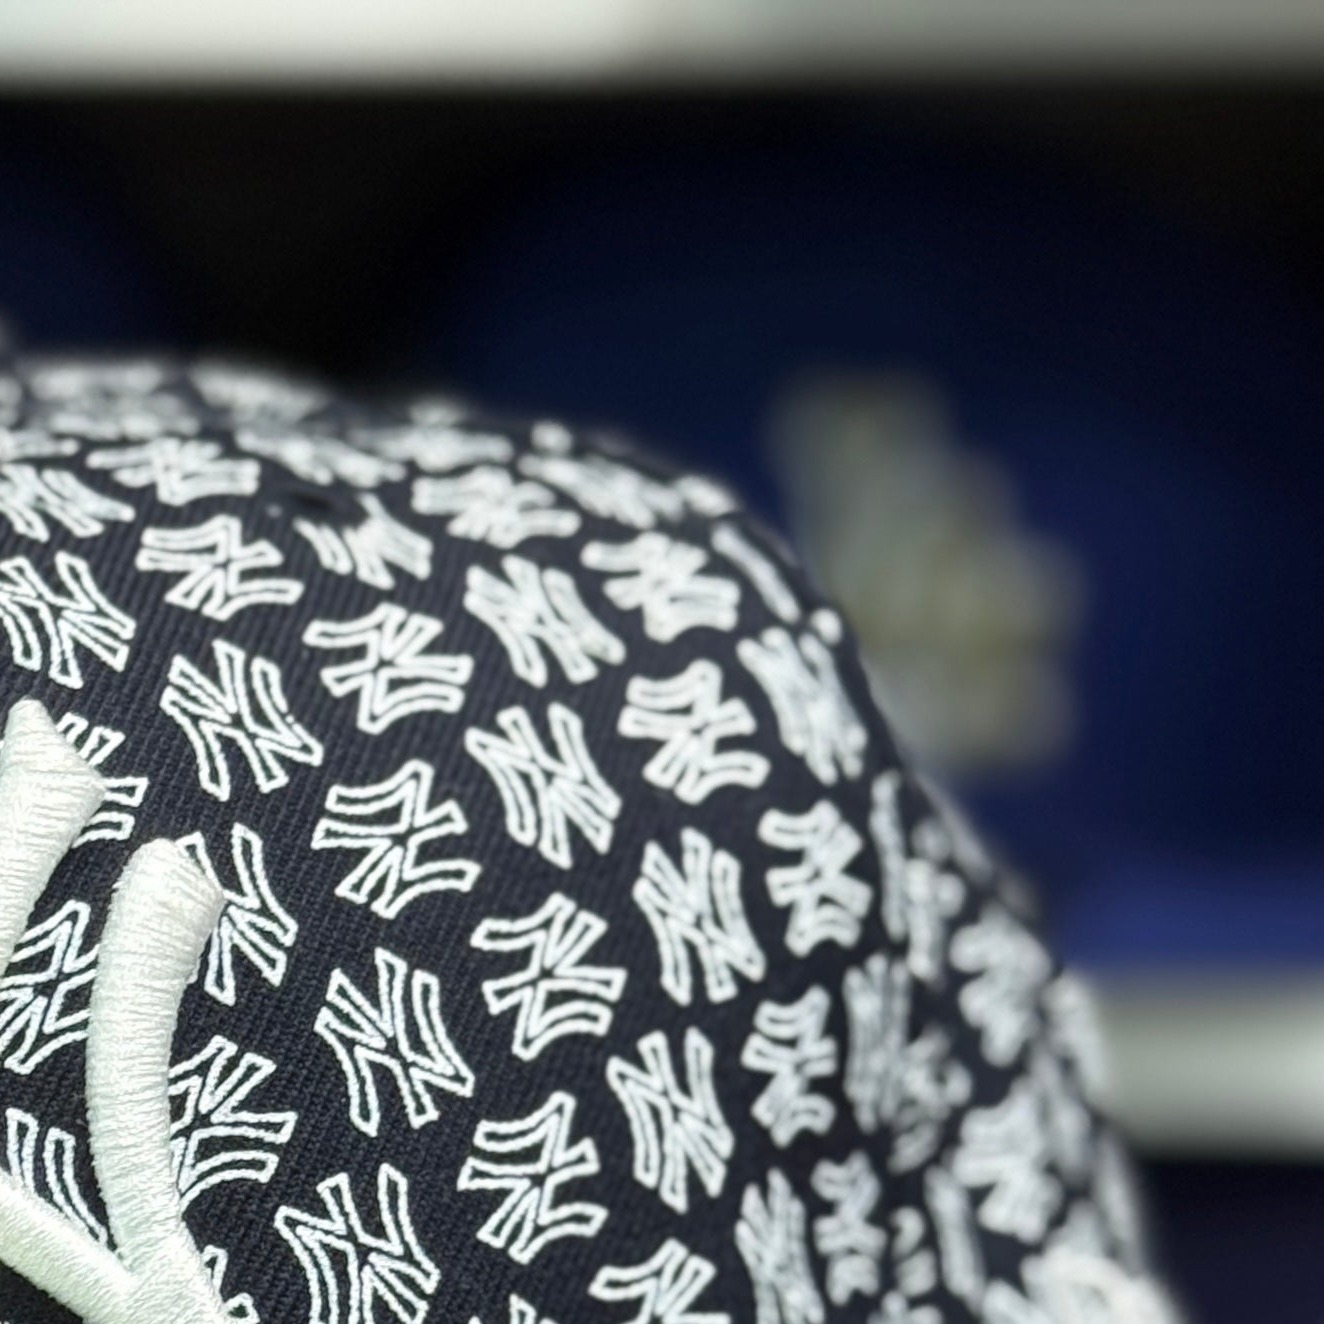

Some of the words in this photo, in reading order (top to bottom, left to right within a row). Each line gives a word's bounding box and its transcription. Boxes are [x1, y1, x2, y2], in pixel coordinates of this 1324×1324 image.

[135, 515, 304, 621] NY
[160, 639, 324, 801] NY
[303, 603, 474, 734] NY
[311, 759, 481, 919] NY
[464, 702, 621, 869] NY
[470, 893, 627, 1061] NY
[633, 828, 765, 1005] NY
[314, 947, 475, 1137] NY
[606, 1027, 734, 1213] NY
[457, 1091, 608, 1264] NY
